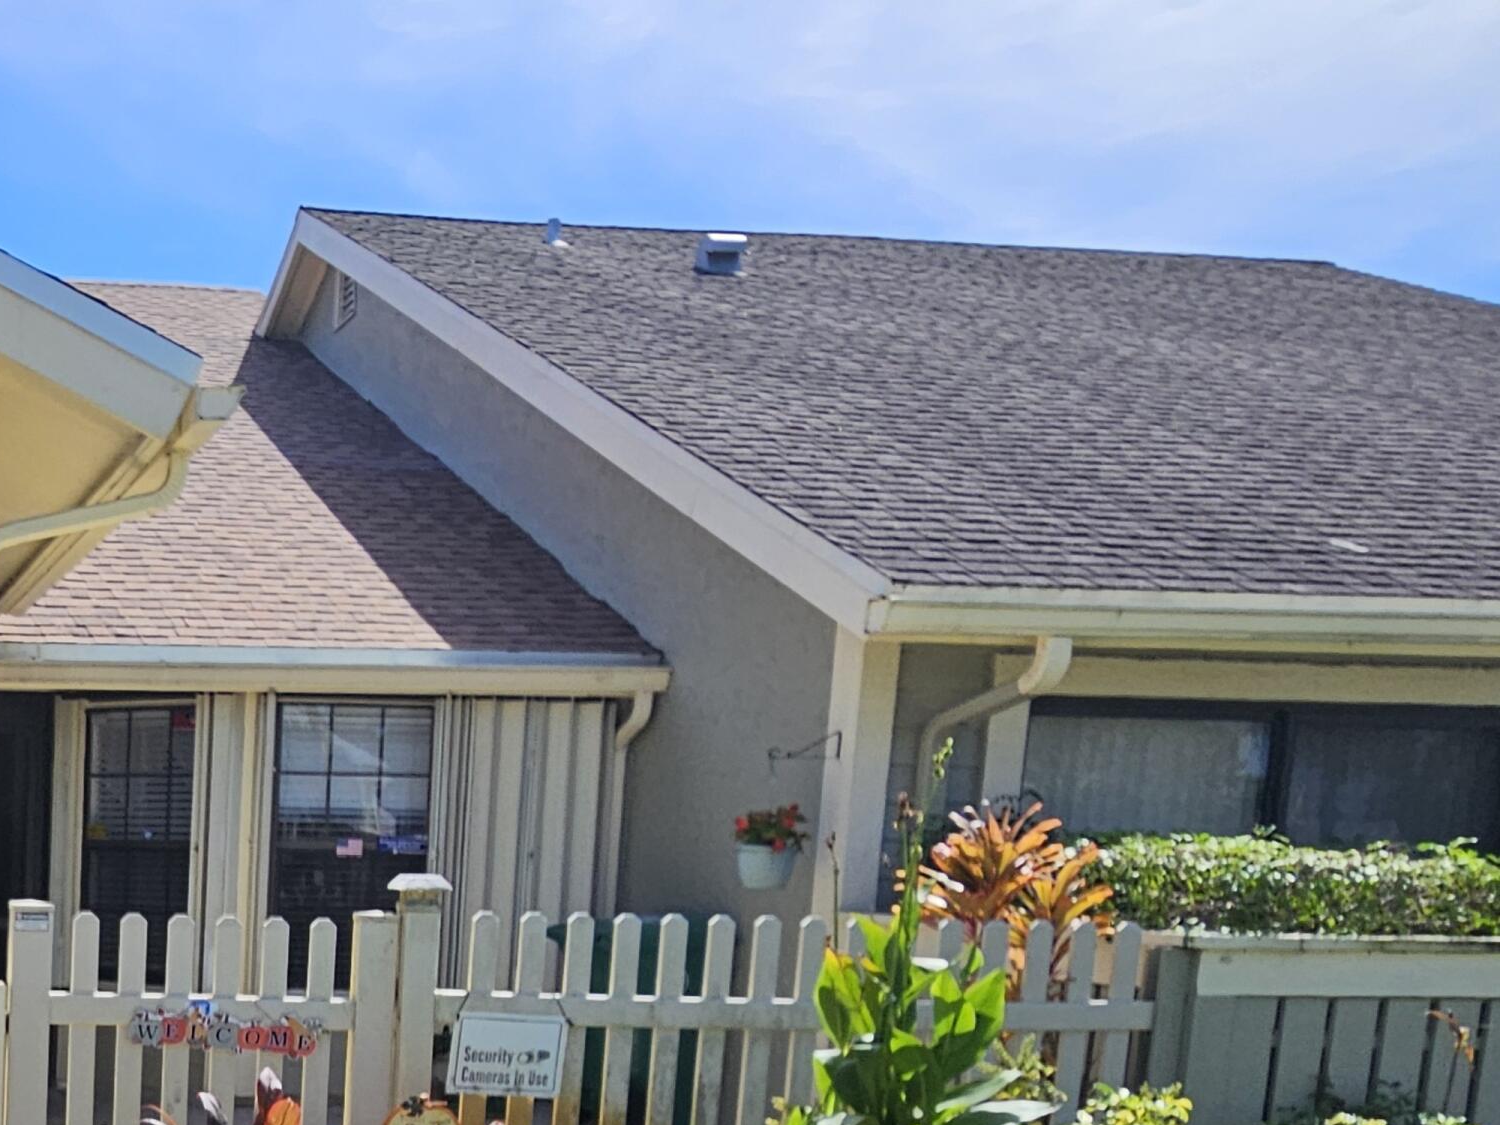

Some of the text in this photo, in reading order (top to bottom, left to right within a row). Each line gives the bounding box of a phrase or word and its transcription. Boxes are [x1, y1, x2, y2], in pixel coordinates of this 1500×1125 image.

[137, 1023, 311, 1050] WELCOME
[463, 1046, 514, 1067] Security
[461, 1066, 510, 1085] Cameras
[528, 1070, 548, 1086] Use
